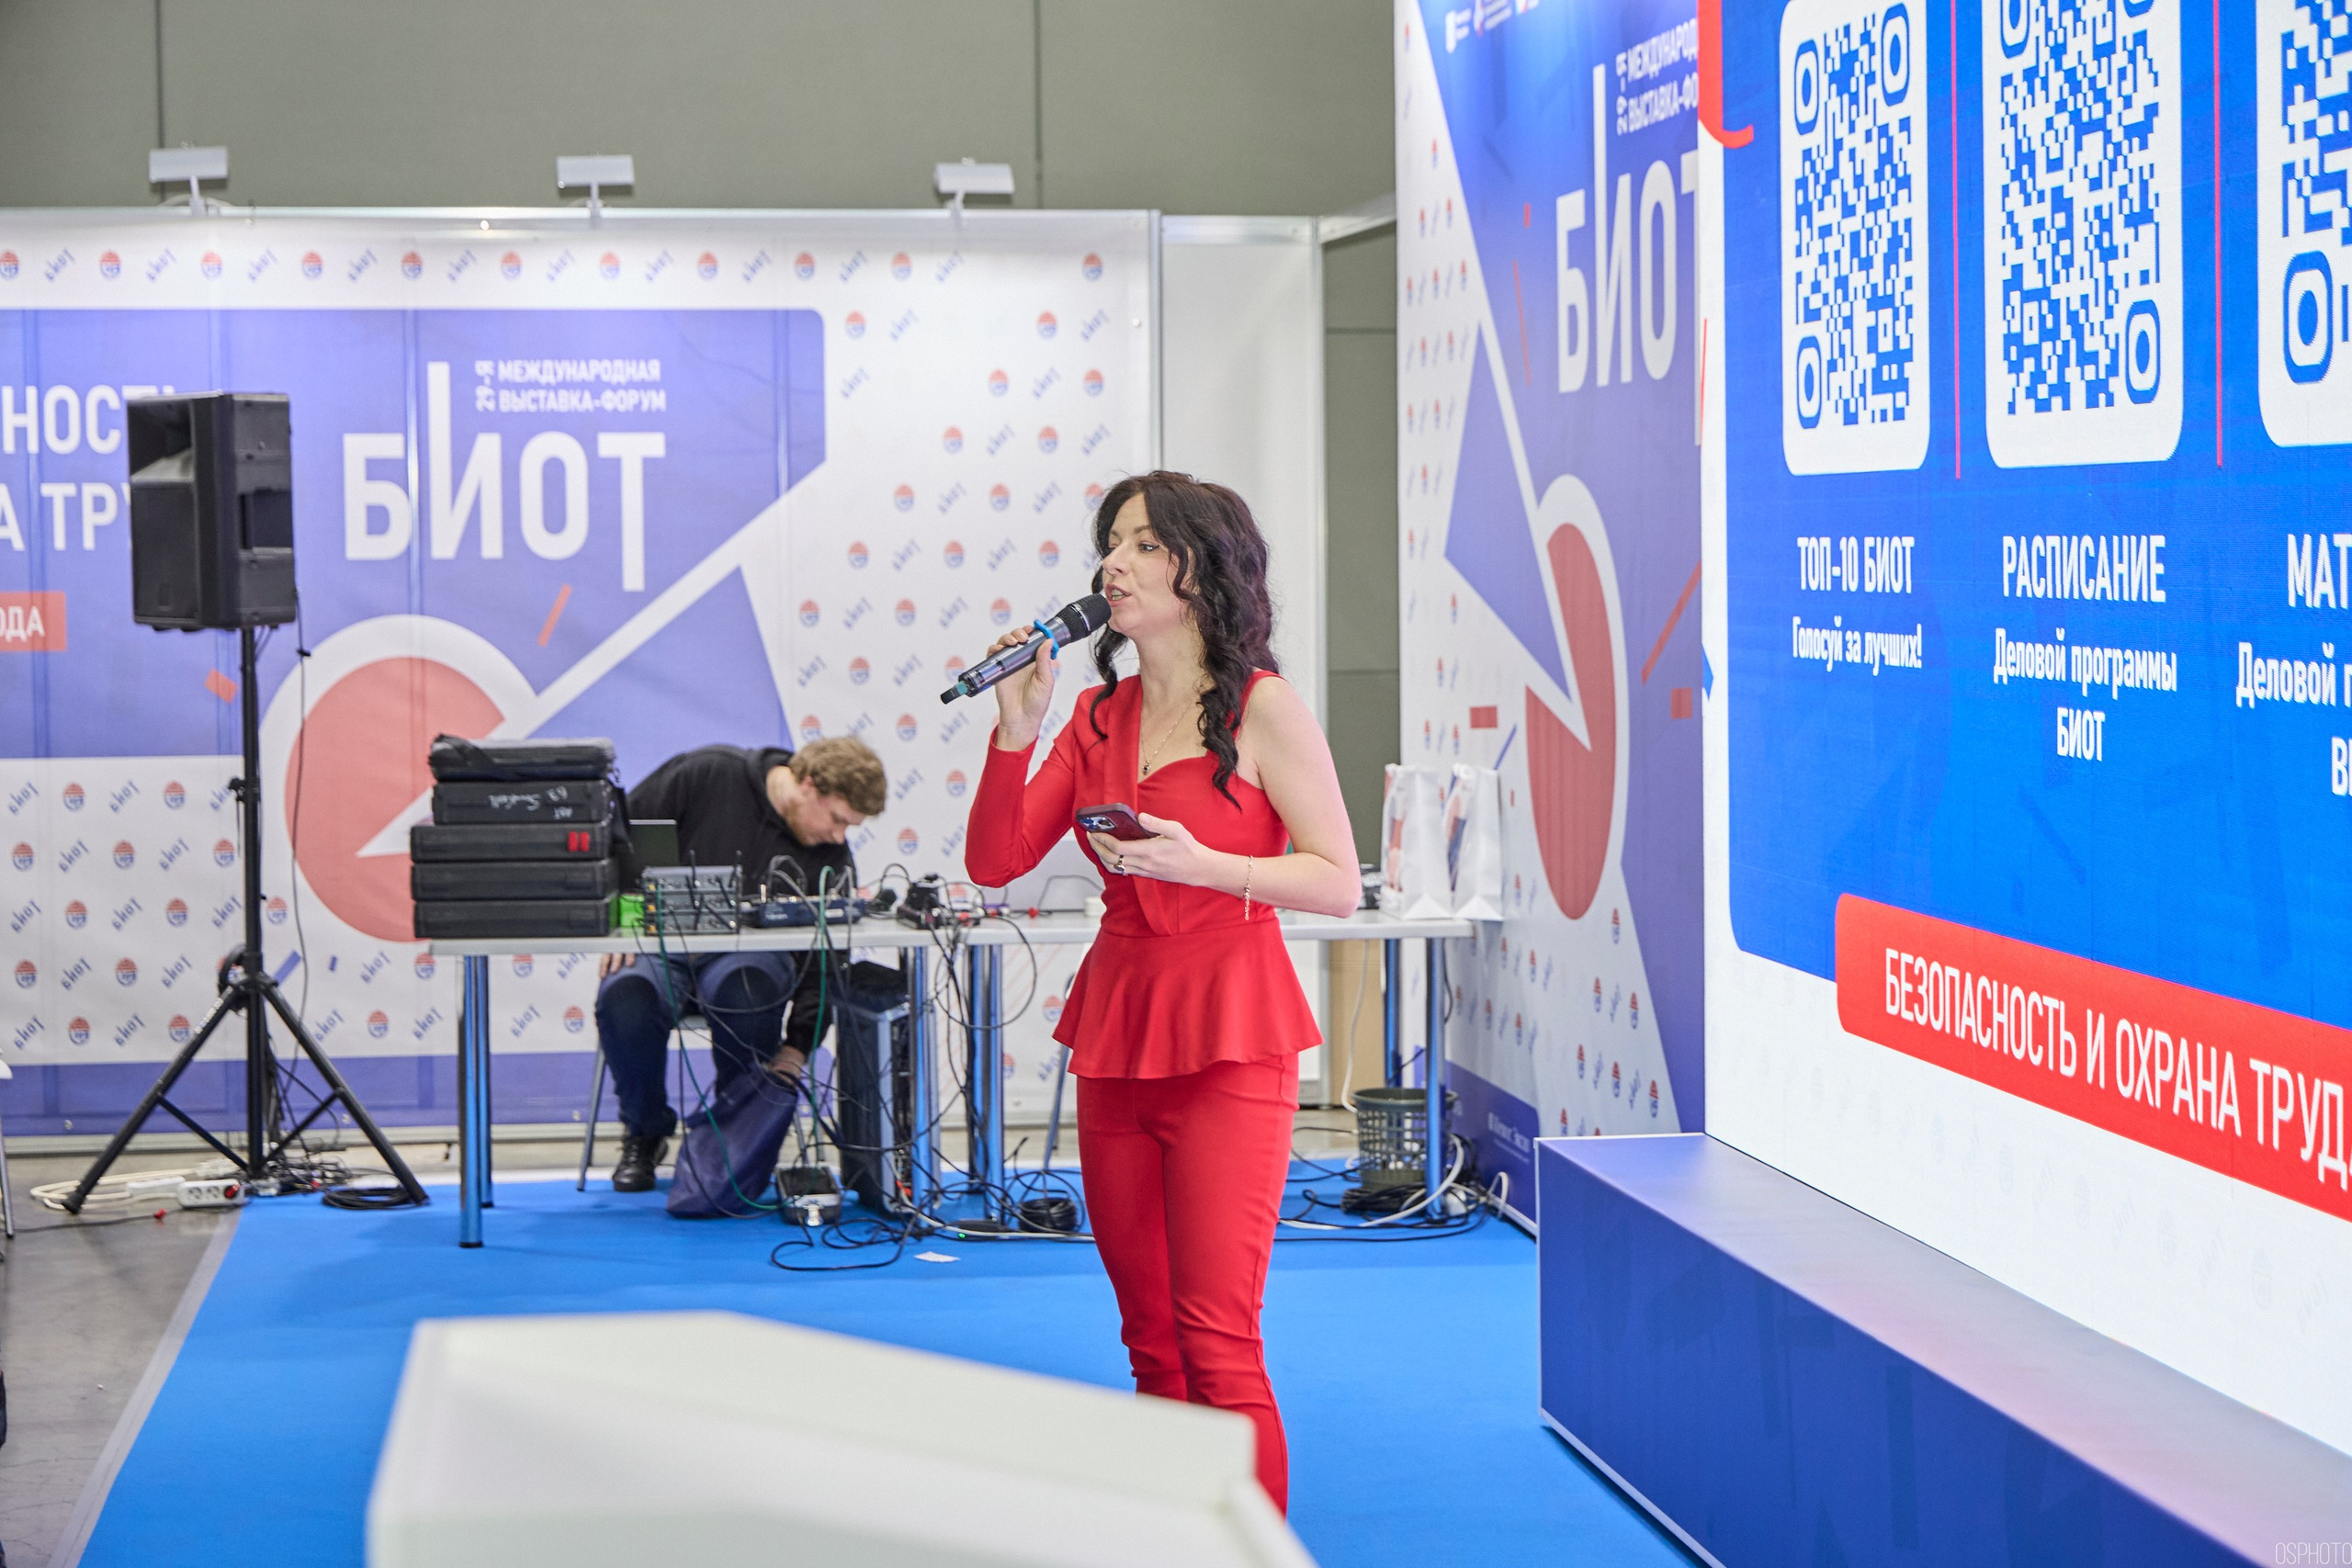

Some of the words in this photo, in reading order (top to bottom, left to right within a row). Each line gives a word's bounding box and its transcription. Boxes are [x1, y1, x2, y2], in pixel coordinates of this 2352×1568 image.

[498, 358, 661, 386] МЕЖДУНАРОДНАЯ
[498, 389, 666, 412] ВЫСТАВКА-ФОРУМ
[343, 362, 667, 592] БИОТ
[41, 482, 131, 551] ТР
[1797, 536, 1859, 593] ТОП-10
[1863, 536, 1915, 594] БИОТ
[2003, 534, 2165, 604] РАСПИСАНИЕ
[1792, 615, 1844, 672] Голосуй
[1846, 634, 1860, 663] за
[1863, 625, 1923, 676] лучших!
[1994, 628, 2066, 684] Деловой
[2071, 644, 2177, 698] программы
[2236, 641, 2336, 708] Деловой
[2056, 707, 2105, 761] БИОТ
[1885, 948, 2076, 1077] БЕЗОПАСНОСТЬ
[2086, 1009, 2106, 1089] И
[2115, 1018, 2241, 1135] ОХРАНА
[2250, 1056, 2352, 1191] ТРУД
